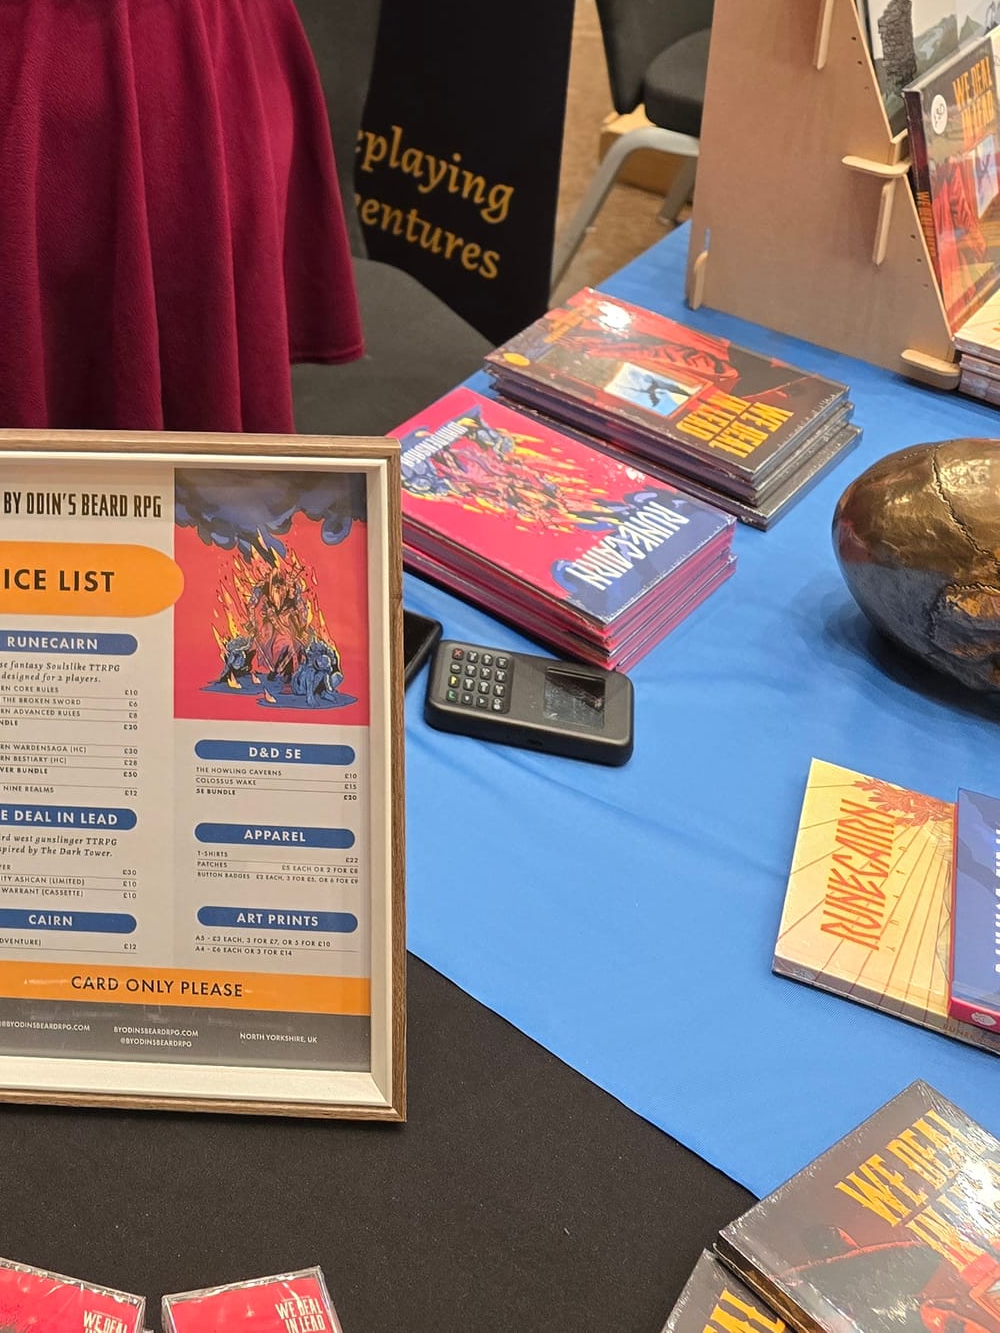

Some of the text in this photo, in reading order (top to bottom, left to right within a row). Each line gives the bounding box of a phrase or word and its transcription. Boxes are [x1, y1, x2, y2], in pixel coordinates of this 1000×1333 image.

[355, 125, 514, 224] playing
[354, 193, 500, 280] entures
[740, 402, 794, 432] WE
[4, 492, 161, 517] BY ODIN'S BEARD RPG
[566, 500, 690, 591] RUNECAIRN
[60, 571, 114, 592] LIST
[7, 637, 98, 650] RUNECAIRN
[10, 660, 42, 670] fantasy
[46, 663, 86, 671] Soulslike
[89, 664, 120, 672] TTRPG
[2, 672, 39, 681] designed
[41, 674, 55, 682] for
[66, 675, 101, 683] players.
[14, 744, 67, 752] WARDENSAGA
[249, 747, 301, 759] D&D 5E
[211, 767, 246, 775] HOWLING
[15, 810, 51, 822] DEAL
[57, 812, 73, 823] IN
[81, 813, 117, 825] LEAD
[35, 835, 83, 845] gunslinger
[244, 830, 306, 842] APPAREL
[28, 846, 38, 854] by
[84, 849, 112, 857] Tower.
[820, 798, 895, 950] RUNECAIRN
[50, 877, 85, 885] (LIMITED)
[42, 889, 83, 897] (CASSETTE)
[29, 915, 73, 926] CAIRN
[237, 913, 319, 926] ART PRINTS
[72, 976, 242, 996] CARD ONLY PLEASE
[114, 1027, 198, 1037] BYODINSBEARDRPG.COM
[267, 1034, 305, 1043] YORKSHIRE,
[120, 1038, 192, 1047] @BYODINSBEARDRPG
[835, 1154, 928, 1227] WE
[275, 1302, 295, 1319] WE
[298, 1297, 323, 1317] DEAL
[84, 1310, 102, 1328] WE
[285, 1315, 326, 1333] IN LEAD
